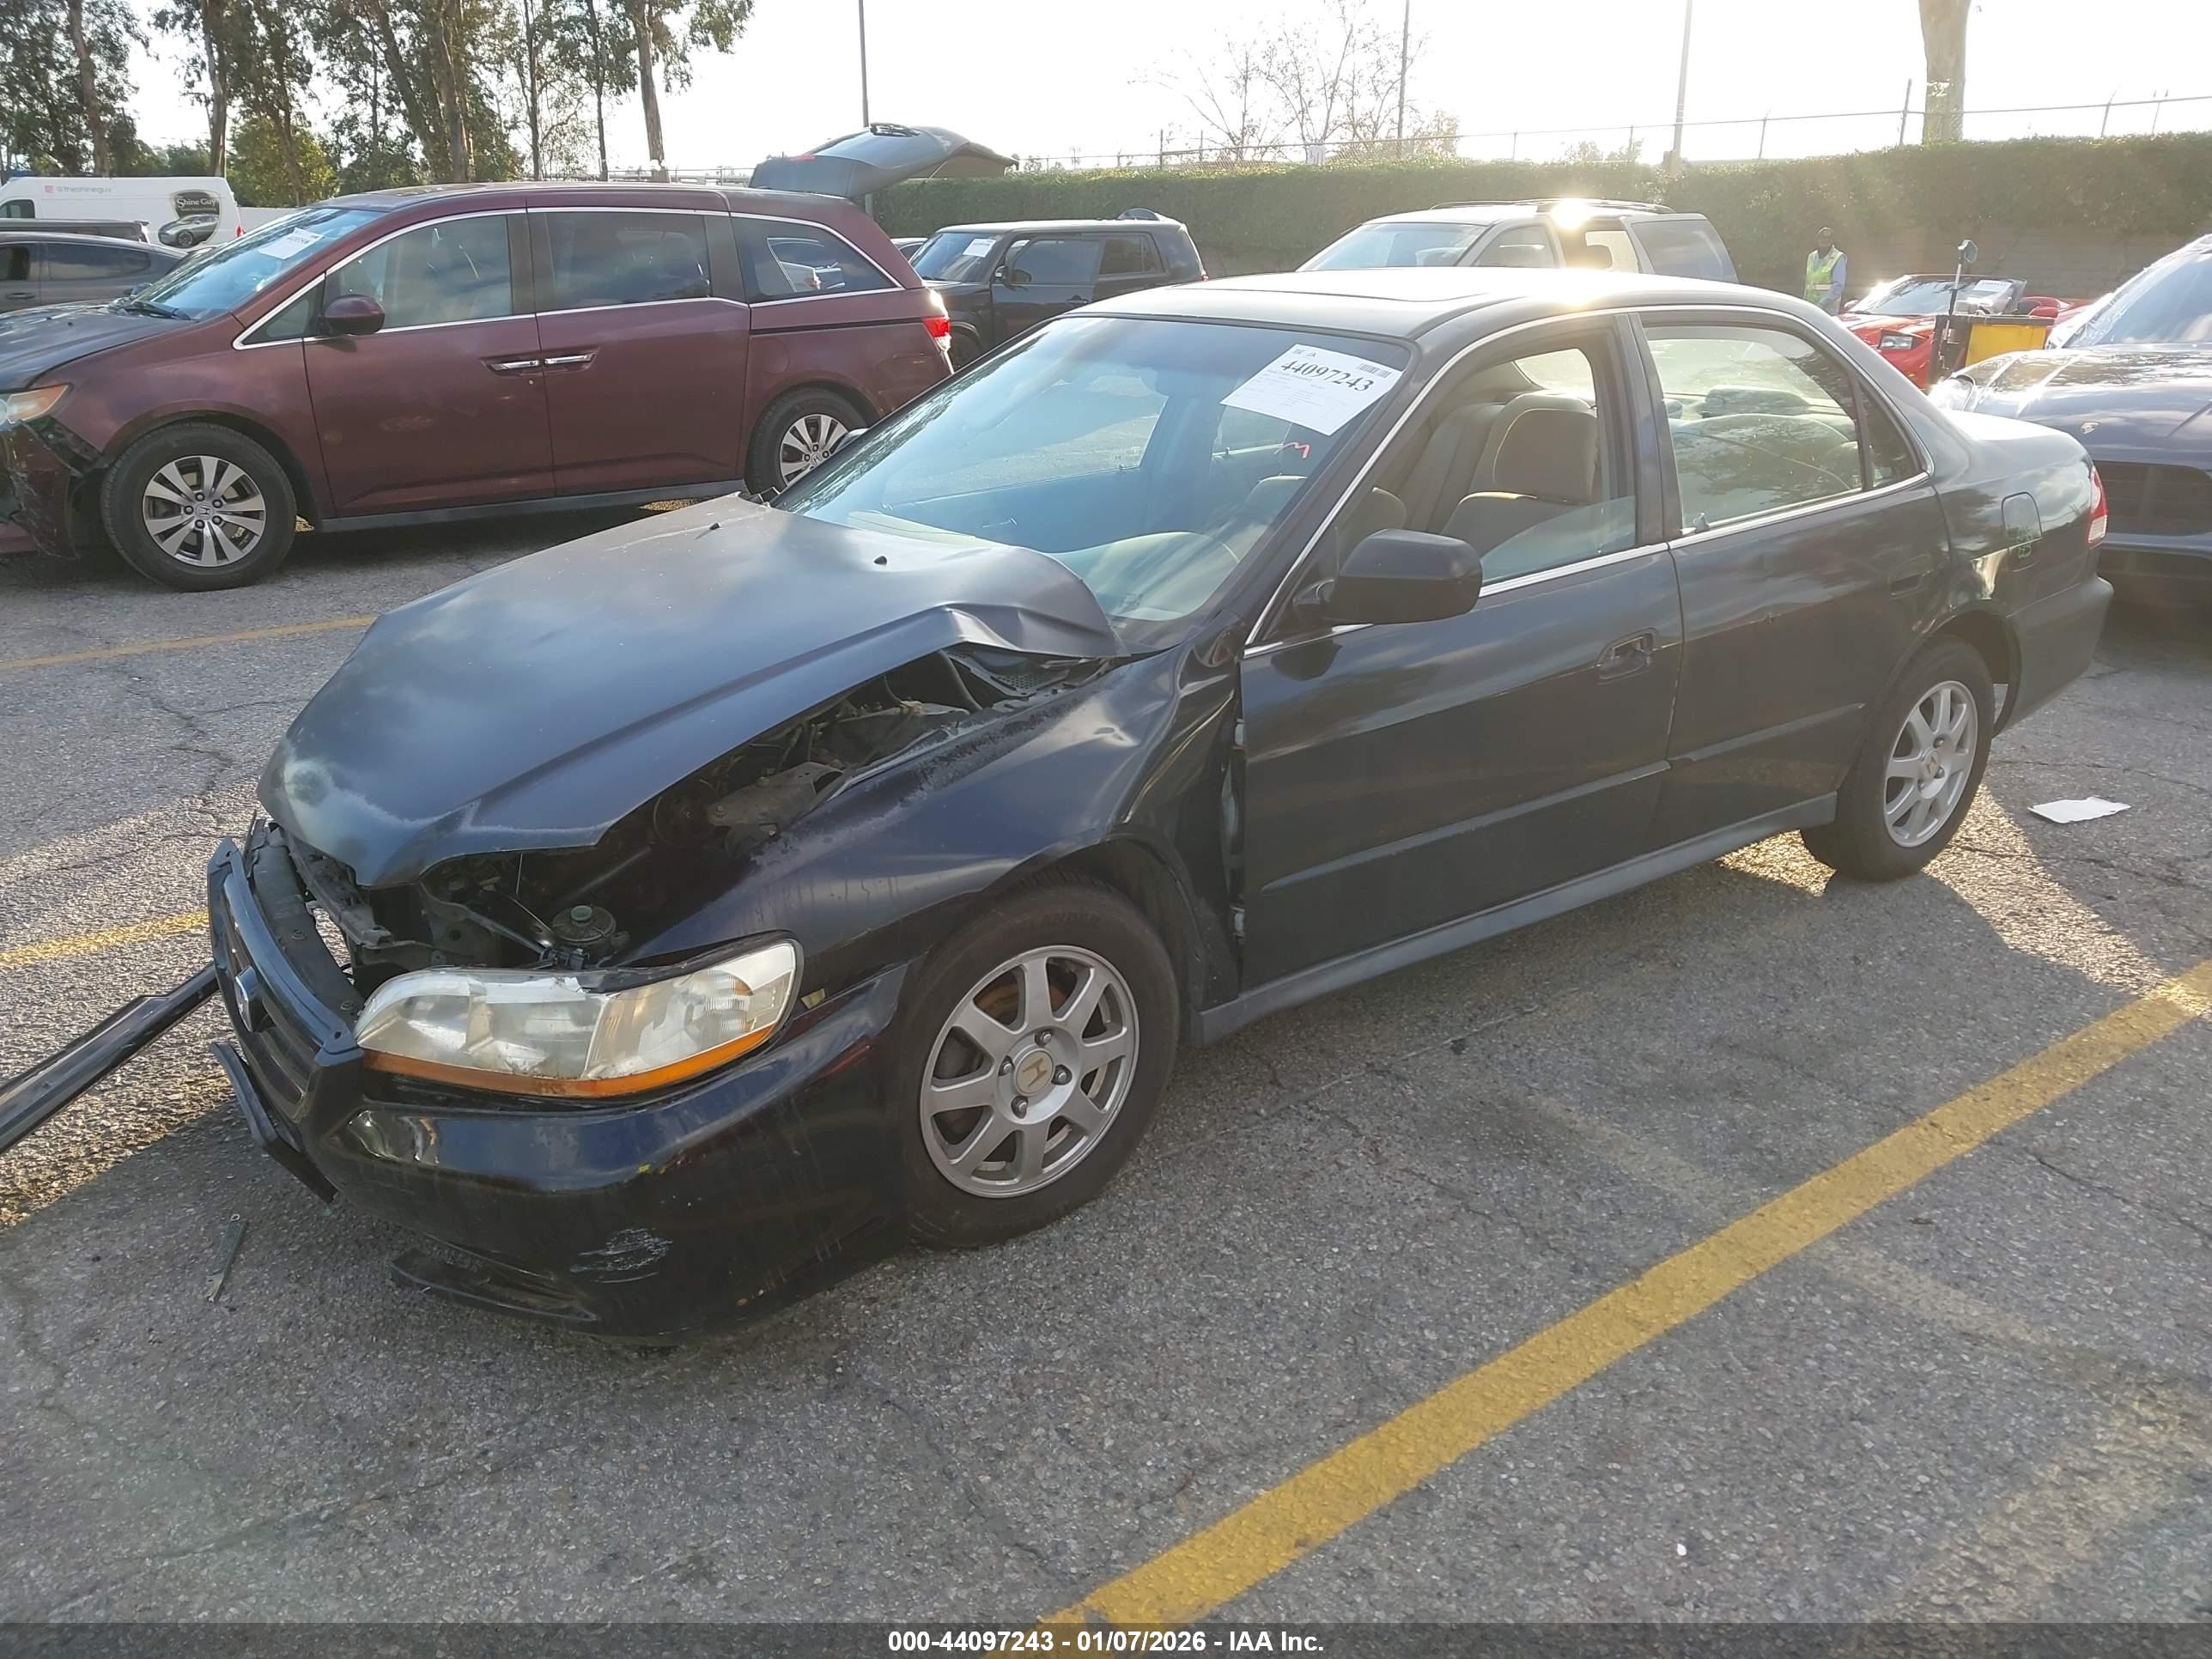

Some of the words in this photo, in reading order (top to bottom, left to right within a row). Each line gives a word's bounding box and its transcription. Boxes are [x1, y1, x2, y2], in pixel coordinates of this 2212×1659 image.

[177, 197, 199, 208] Shine
[200, 198, 216, 207] Guy
[1280, 360, 1375, 392] 44097243
